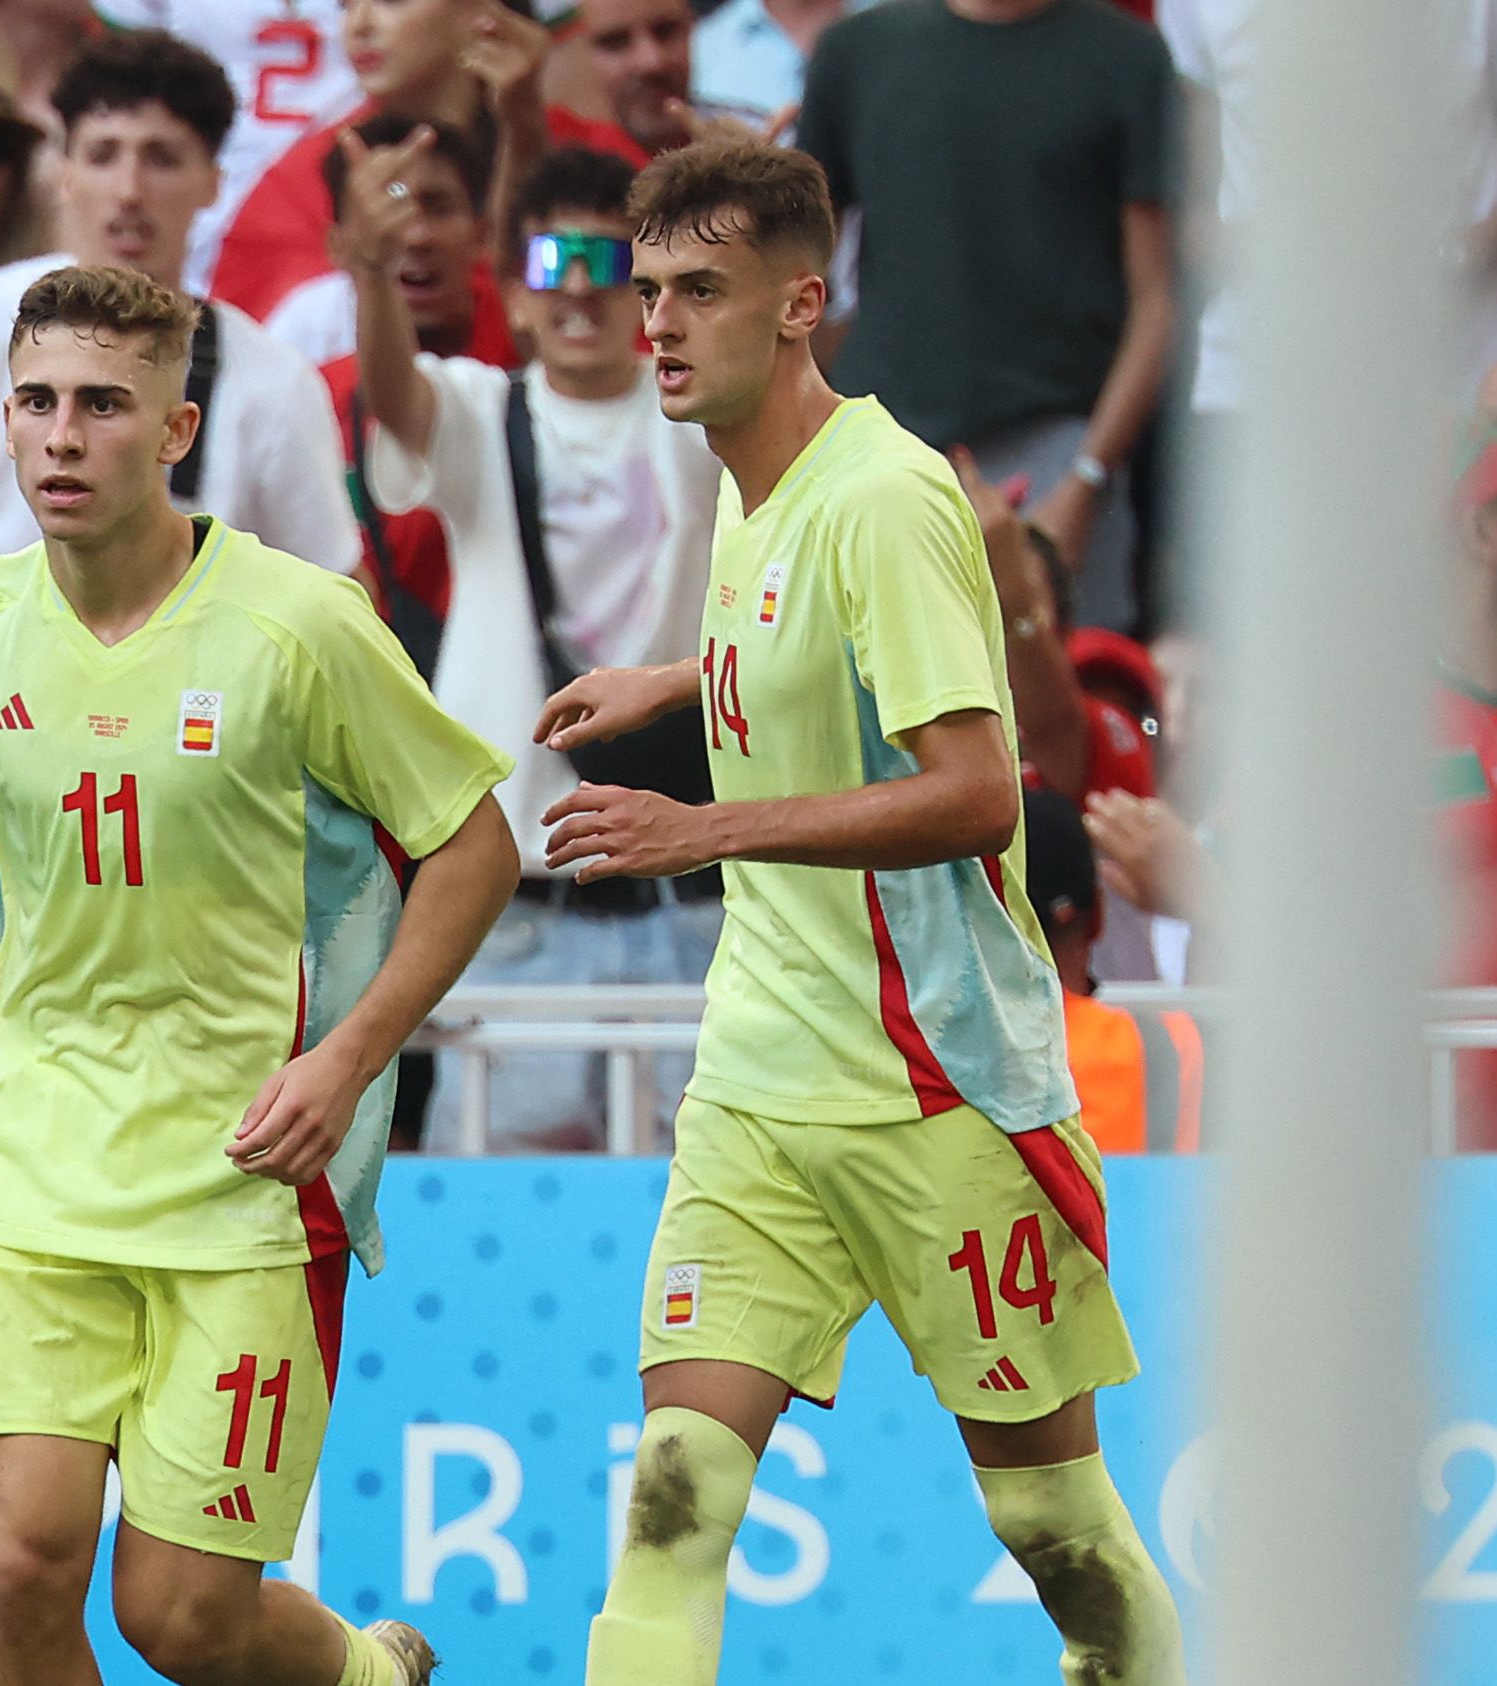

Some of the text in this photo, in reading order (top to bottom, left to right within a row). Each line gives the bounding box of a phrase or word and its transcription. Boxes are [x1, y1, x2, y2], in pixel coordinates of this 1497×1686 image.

[254, 20, 321, 121] 2
[703, 637, 751, 757] 14
[62, 771, 144, 887] 11
[948, 1213, 1056, 1339] 14
[215, 1353, 291, 1473] 11
